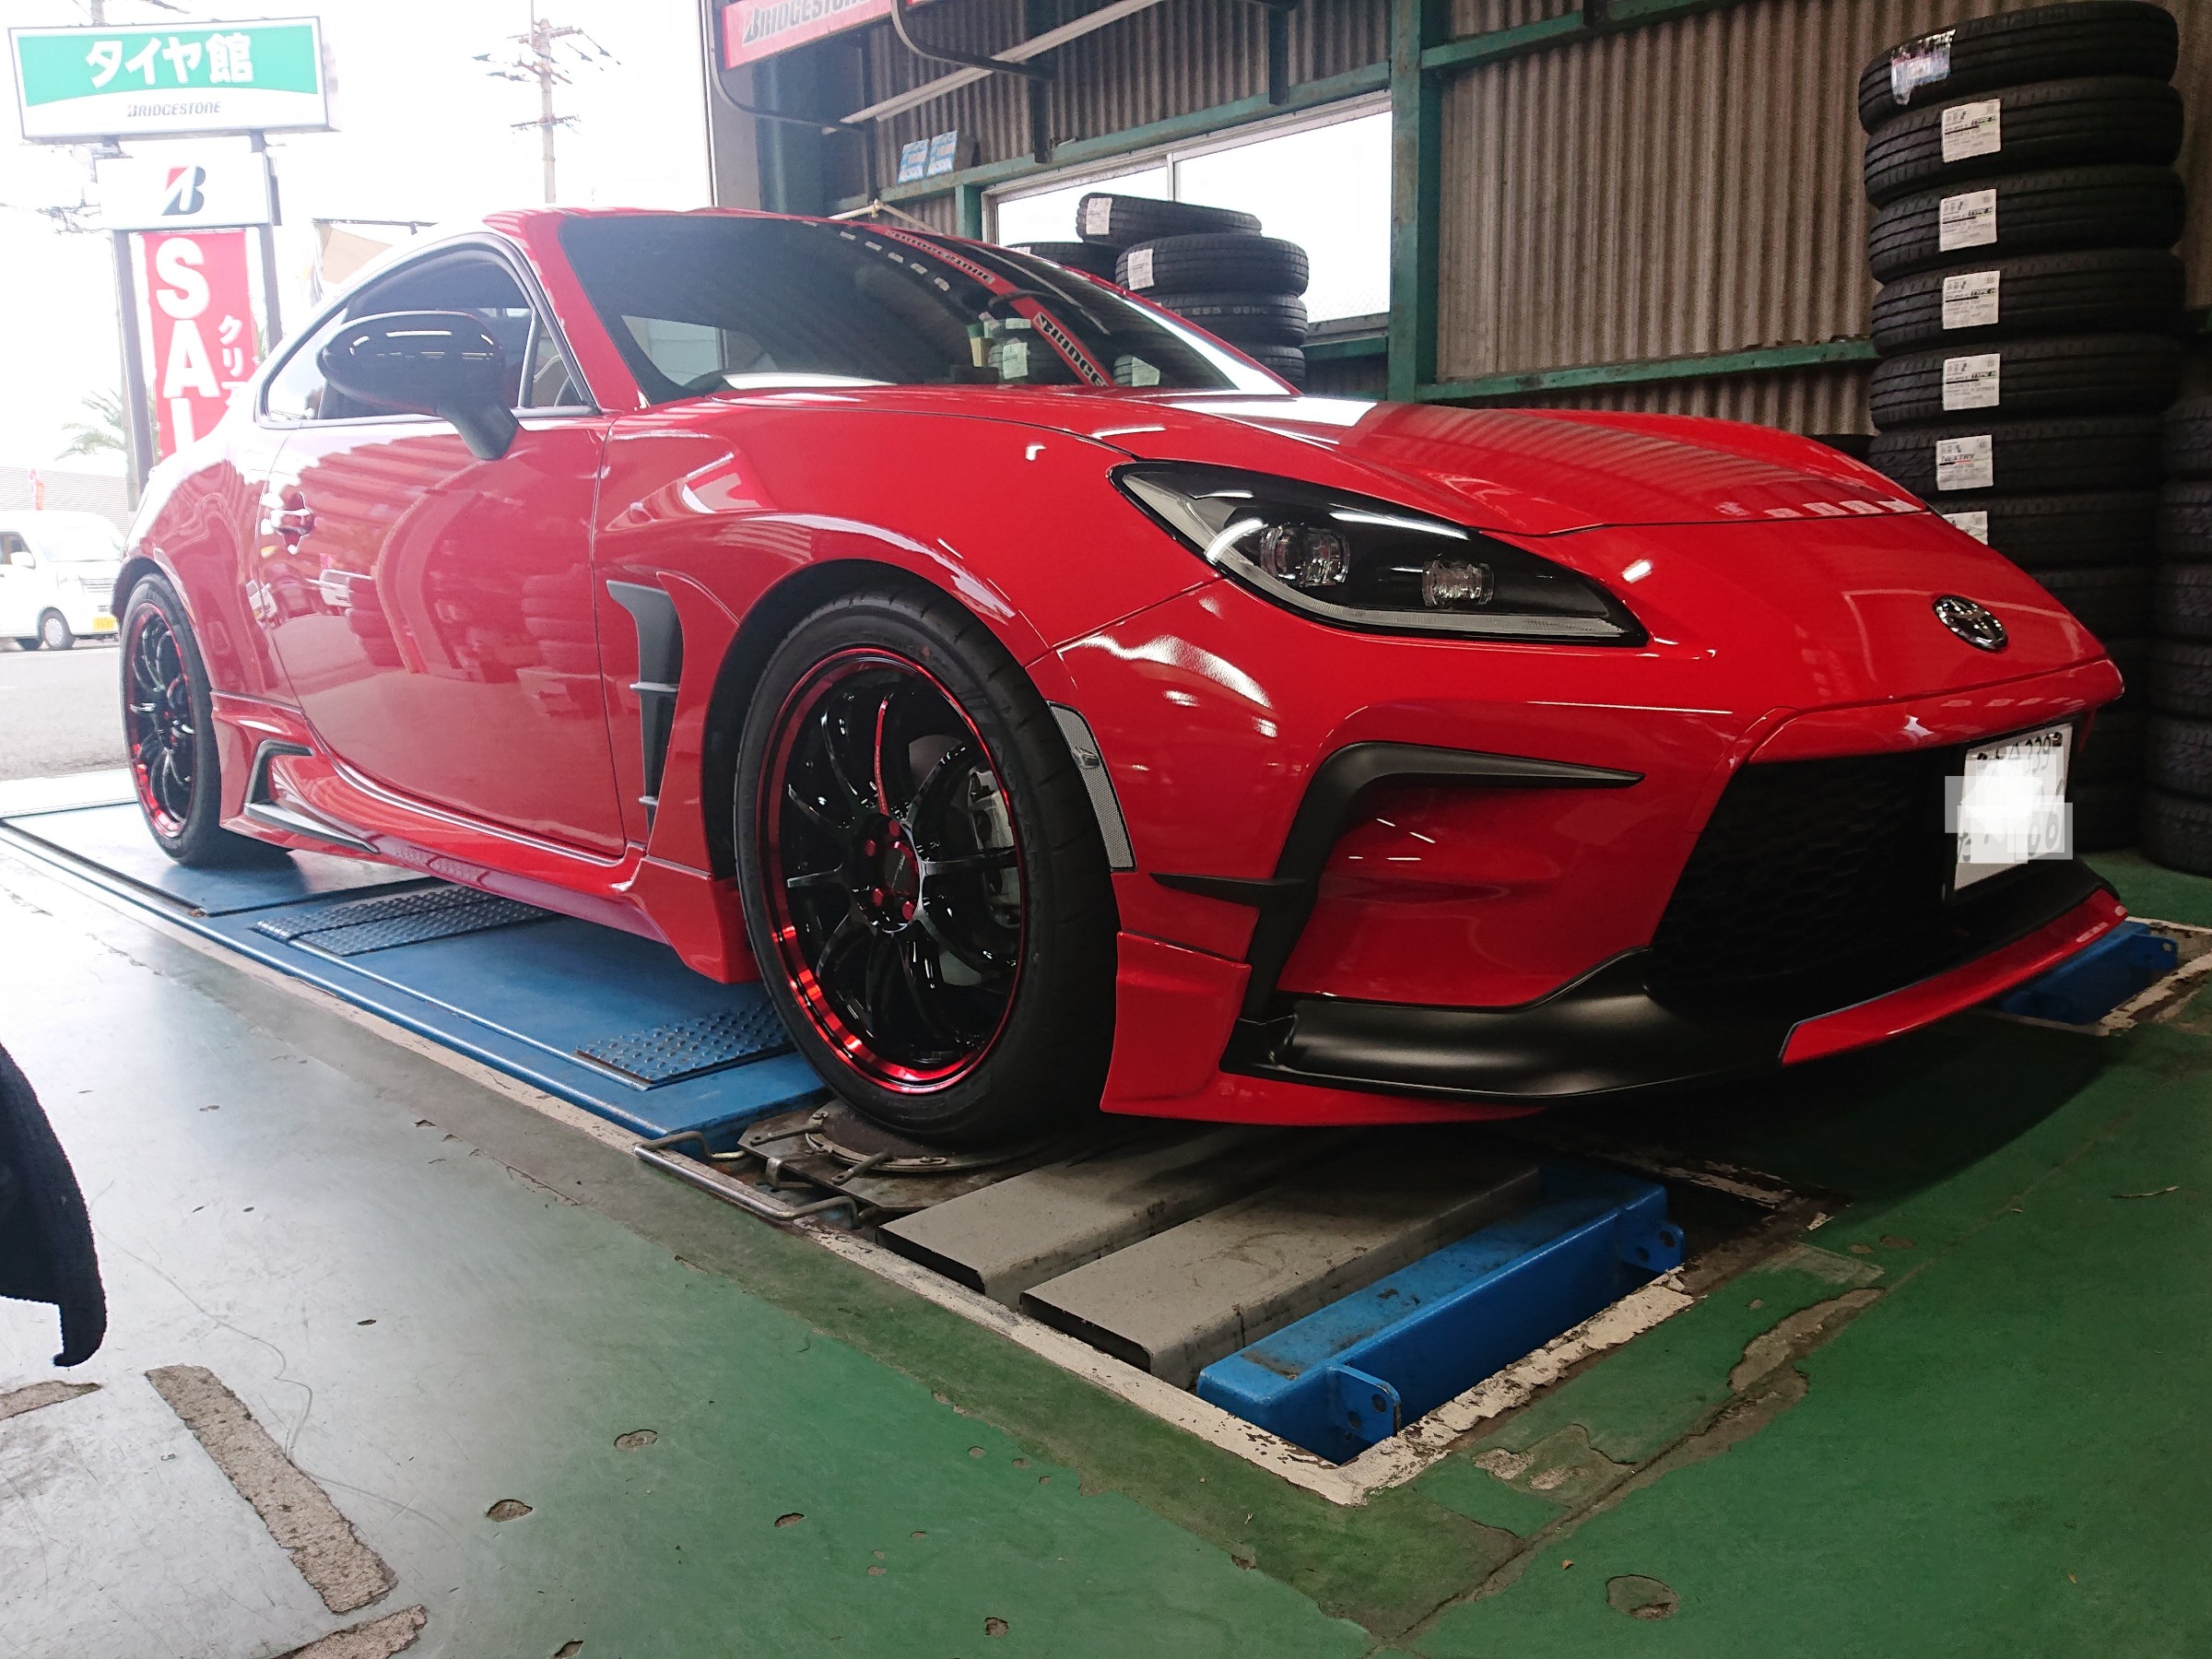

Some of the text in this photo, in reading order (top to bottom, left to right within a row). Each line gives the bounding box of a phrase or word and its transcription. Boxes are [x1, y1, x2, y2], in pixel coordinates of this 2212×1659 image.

[743, 0, 868, 44] BRIDGEST
[86, 33, 254, 88] タイヤ館
[127, 101, 221, 117] BRIDGESTONE
